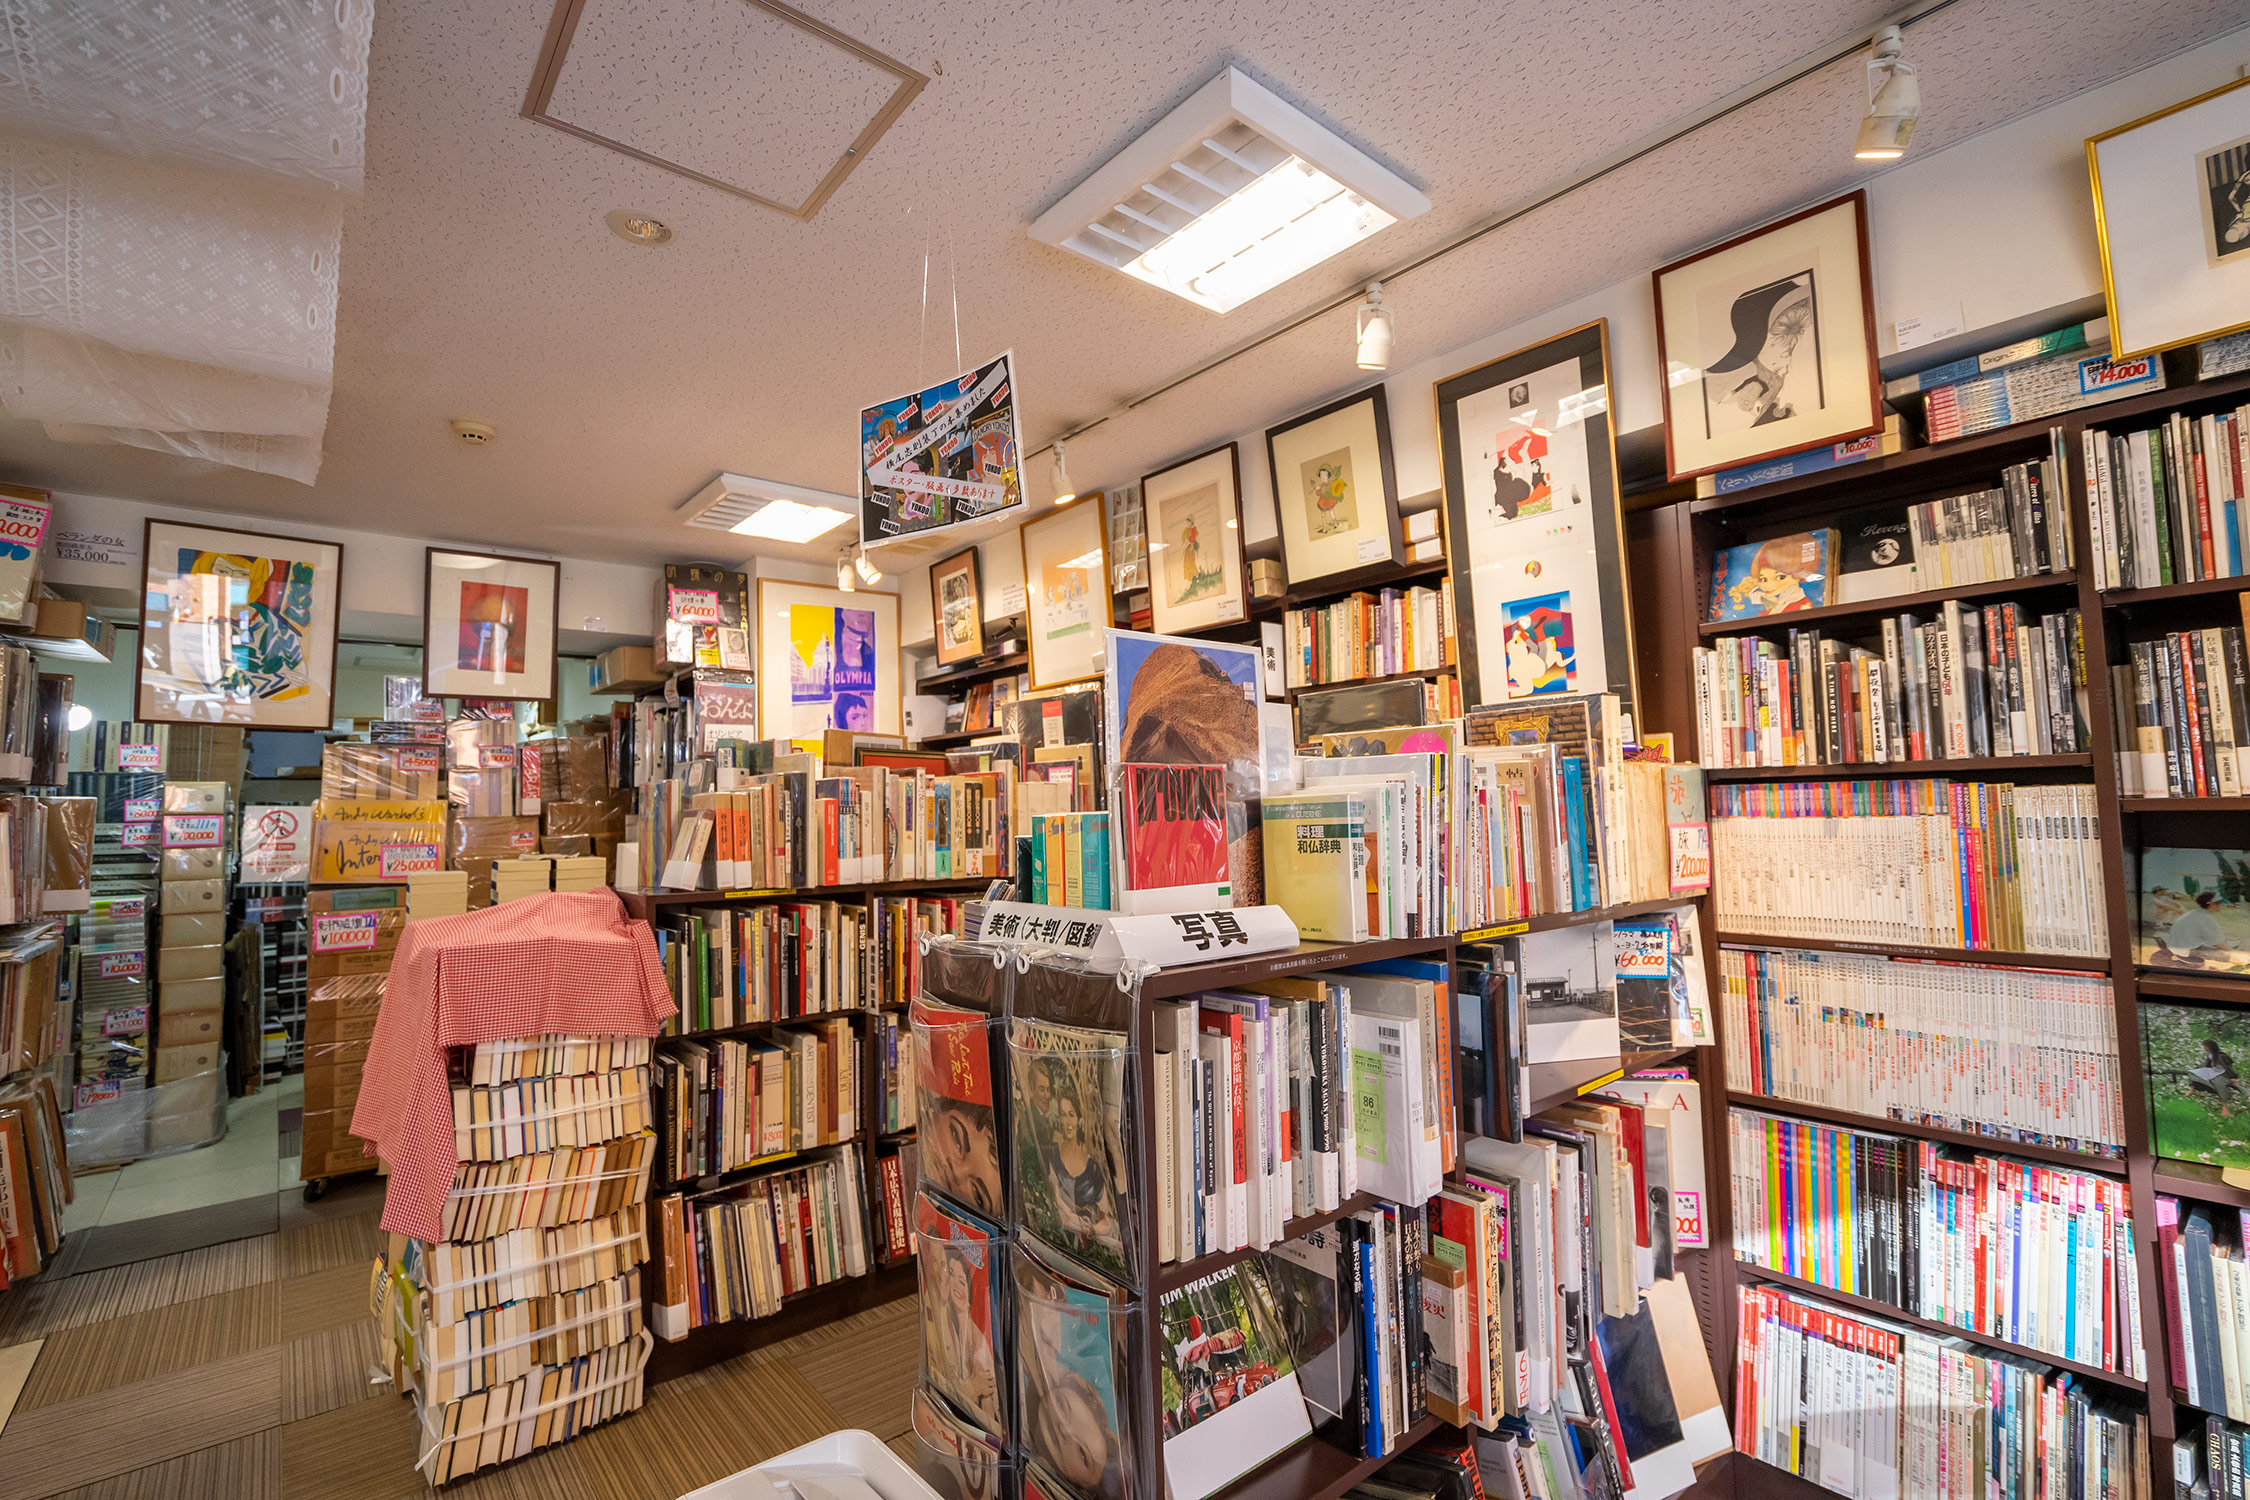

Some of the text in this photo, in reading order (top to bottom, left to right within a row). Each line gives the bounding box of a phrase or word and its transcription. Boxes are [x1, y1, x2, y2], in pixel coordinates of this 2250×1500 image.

[958, 372, 976, 392] YOKOO
[991, 384, 1008, 405] YOKOO
[898, 404, 917, 422] YOKOO
[924, 403, 943, 422] YOKOO
[875, 436, 892, 454] YOKOO
[940, 437, 958, 455] YOKOO
[985, 463, 1001, 475] YOKOO
[873, 493, 890, 505] YOKOO
[911, 503, 930, 516] YOKOO
[958, 502, 976, 515] YOKOO
[881, 520, 899, 533] YOKOO
[1266, 646, 1276, 671] 美術
[835, 670, 873, 685] OLYMPIA
[699, 696, 753, 720] おんな
[706, 729, 743, 740] オリンピア
[1136, 767, 1225, 827] provoke
[1297, 825, 1325, 838] 料理
[1297, 839, 1341, 854] 和仏辞典
[1171, 911, 1249, 951] 写真
[1232, 1040, 1243, 1118] 京都祇園石段下
[1363, 1096, 1374, 1108] 86
[1404, 1223, 1414, 1276] 日本の祭り
[1413, 1219, 1421, 1273] 日本の祭り
[1160, 1265, 1238, 1306] TIM WALKER
[1519, 1353, 1529, 1405] 6万円
[2210, 1432, 2221, 1471] CHAOS
